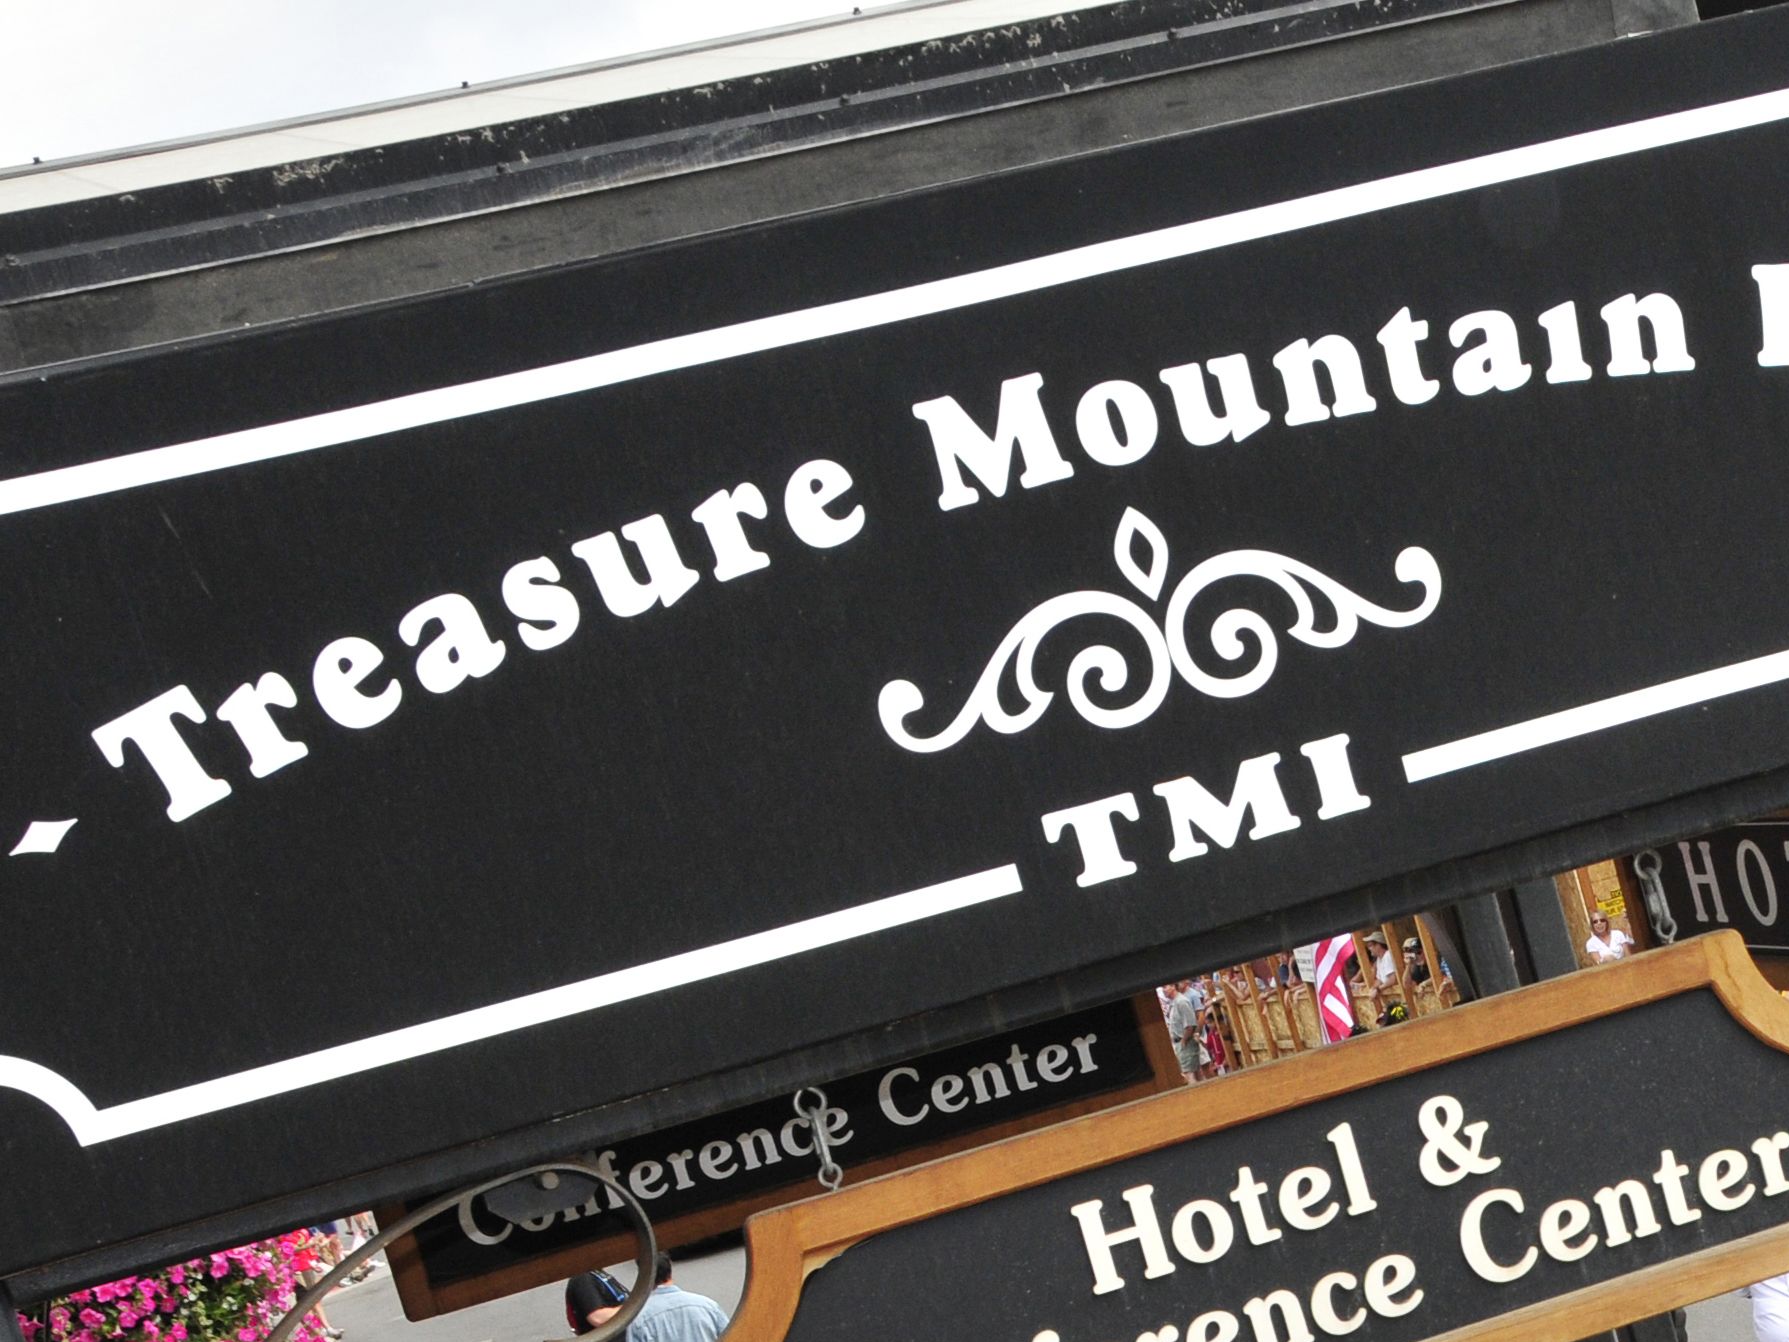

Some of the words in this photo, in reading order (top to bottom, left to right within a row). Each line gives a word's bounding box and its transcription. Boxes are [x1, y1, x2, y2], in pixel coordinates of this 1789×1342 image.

[91, 459, 865, 822] Treasure
[912, 293, 1696, 511] Mountain
[1041, 733, 1371, 887] TMI
[878, 1033, 1099, 1126] Center
[1071, 1122, 1377, 1296] Hotel
[1418, 1095, 1501, 1187] &
